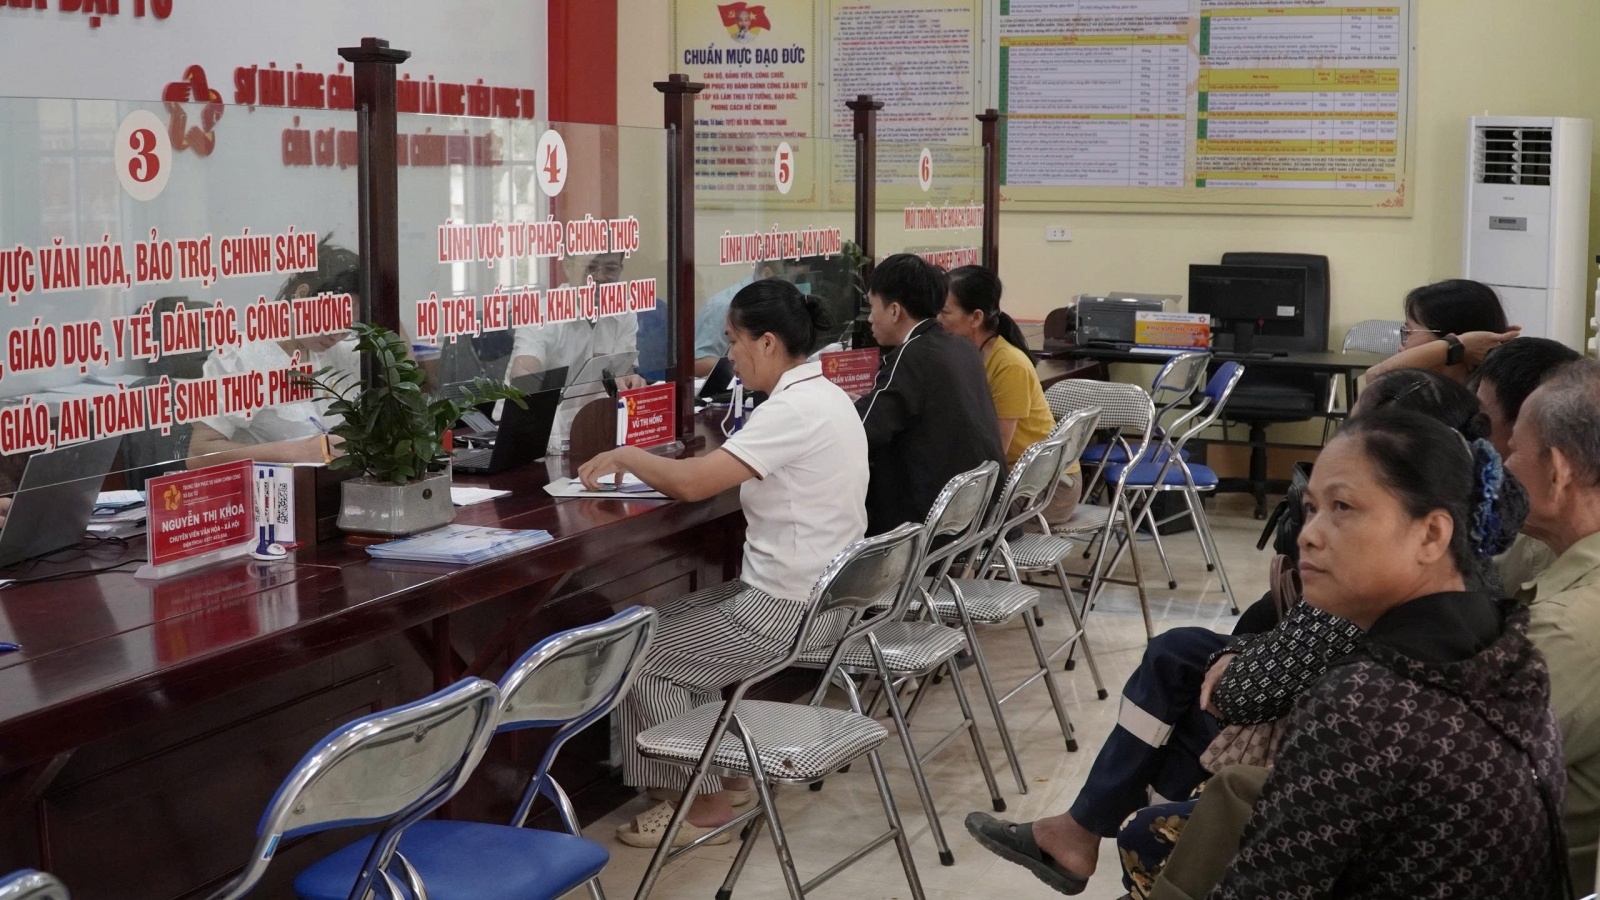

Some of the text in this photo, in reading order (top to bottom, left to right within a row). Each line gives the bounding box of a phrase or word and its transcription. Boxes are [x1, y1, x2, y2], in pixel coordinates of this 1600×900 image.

[684, 43, 805, 68] CHUẨN MỰC ĐẠO ĐỨC
[129, 128, 160, 182] 3
[543, 144, 561, 183] 4
[779, 152, 790, 184] 5
[921, 156, 930, 183] 6
[40, 238, 79, 290] VĂN
[87, 235, 131, 289] HÓA,
[137, 228, 171, 282] BẢO
[178, 237, 217, 286] TRỢ,
[221, 228, 270, 276] CHÍNH
[276, 226, 317, 271] SÁCH
[439, 215, 639, 267] LĨNH VỰC TƯ PHÁP, CHỨNG THỰC
[720, 225, 841, 268] LĨNH VỰC ĐẤT ĐAI, XÂY DỰNG
[417, 276, 656, 344] HỘ TỊCH, KẾT HÔN, KHAI TỬ, KHAI SINH
[9, 293, 352, 374] GIÁO DỤC, Y TẾ, DÂN TỘC, CÔNG THƯƠNG
[1, 351, 313, 452] GIÁO, AN TOÀN VỆ SINH THỰC PHẨM
[632, 418, 640, 428] VŨ
[640, 418, 649, 428] THỊ
[162, 503, 245, 533] NGUYỄN THỊ KHOA
[169, 531, 189, 543] CHUYÊN
[189, 530, 200, 539] VIÊN
[200, 528, 211, 537] VĂN
